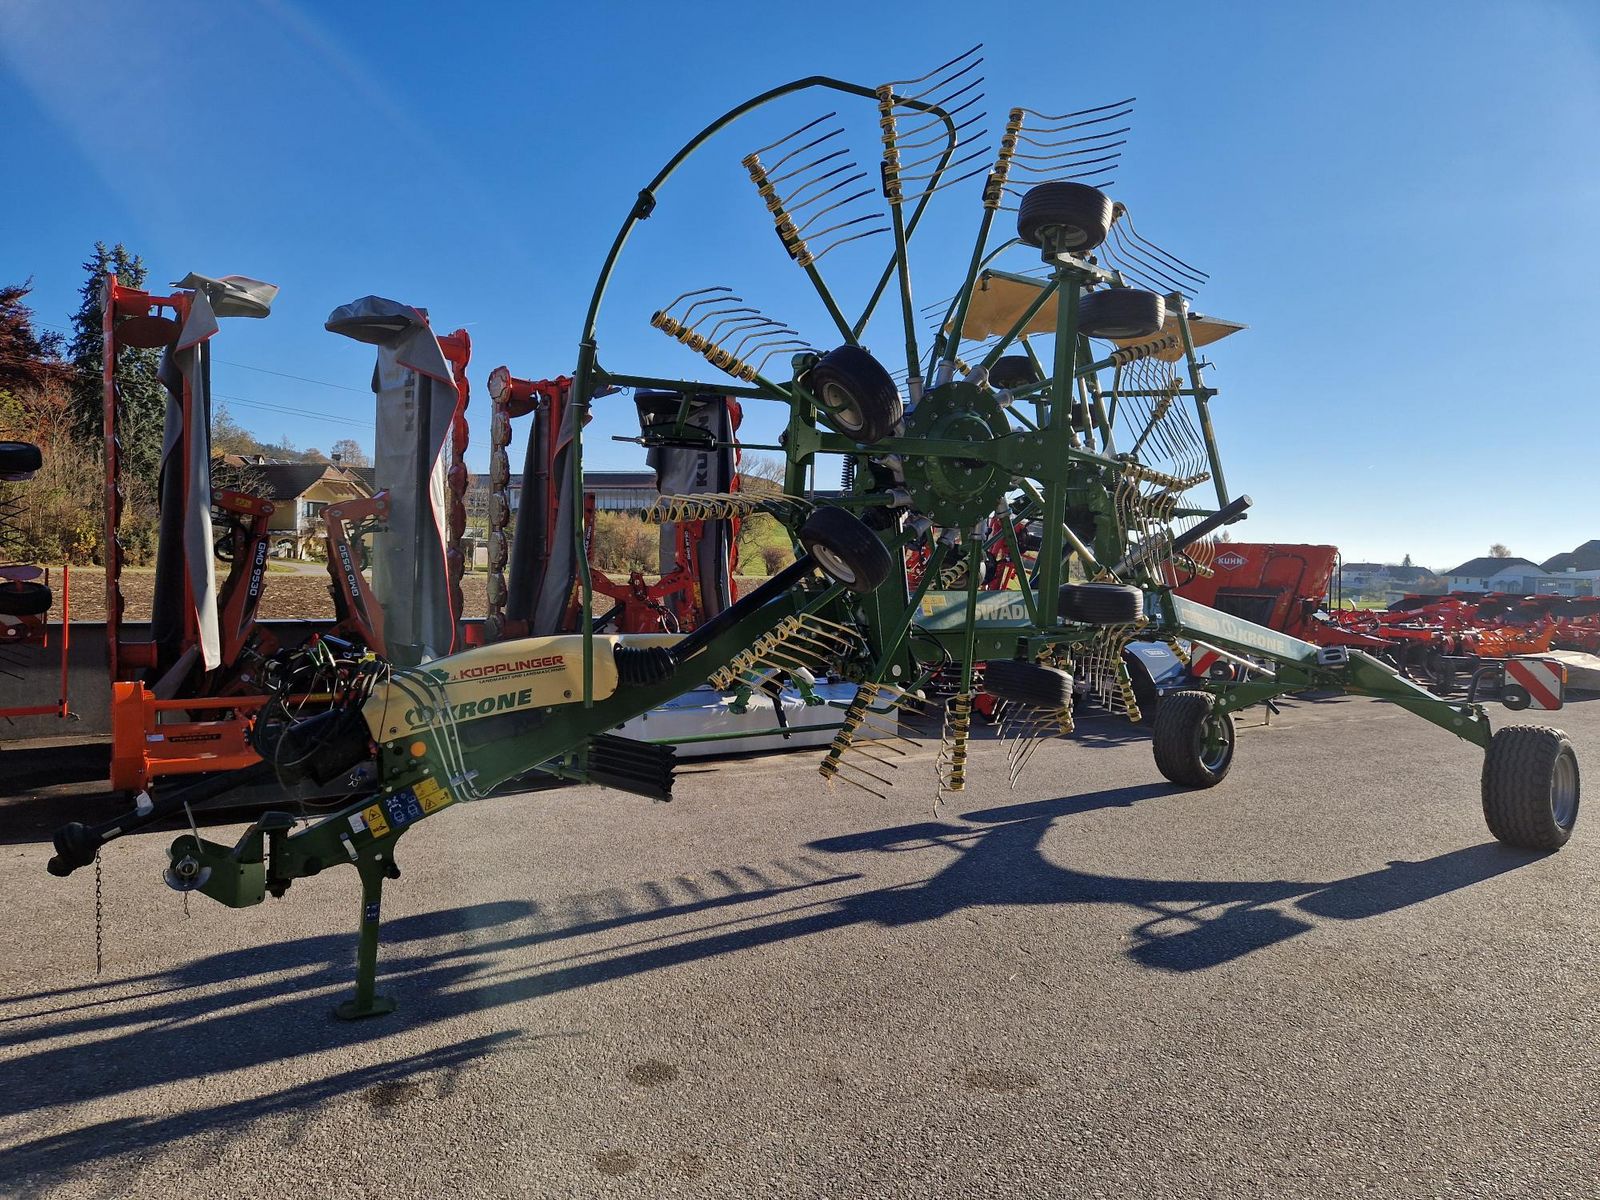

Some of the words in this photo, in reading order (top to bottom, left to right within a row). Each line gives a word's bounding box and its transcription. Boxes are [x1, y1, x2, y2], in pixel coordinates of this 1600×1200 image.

[257, 543, 266, 566] GMD
[339, 545, 351, 571] 9530
[1218, 557, 1243, 565] KUHN
[250, 569, 261, 596] 9530
[347, 574, 359, 597] GMD
[1237, 629, 1286, 653] KRONE
[460, 656, 564, 678] KOPPLINGER
[440, 689, 532, 723] KRONE
